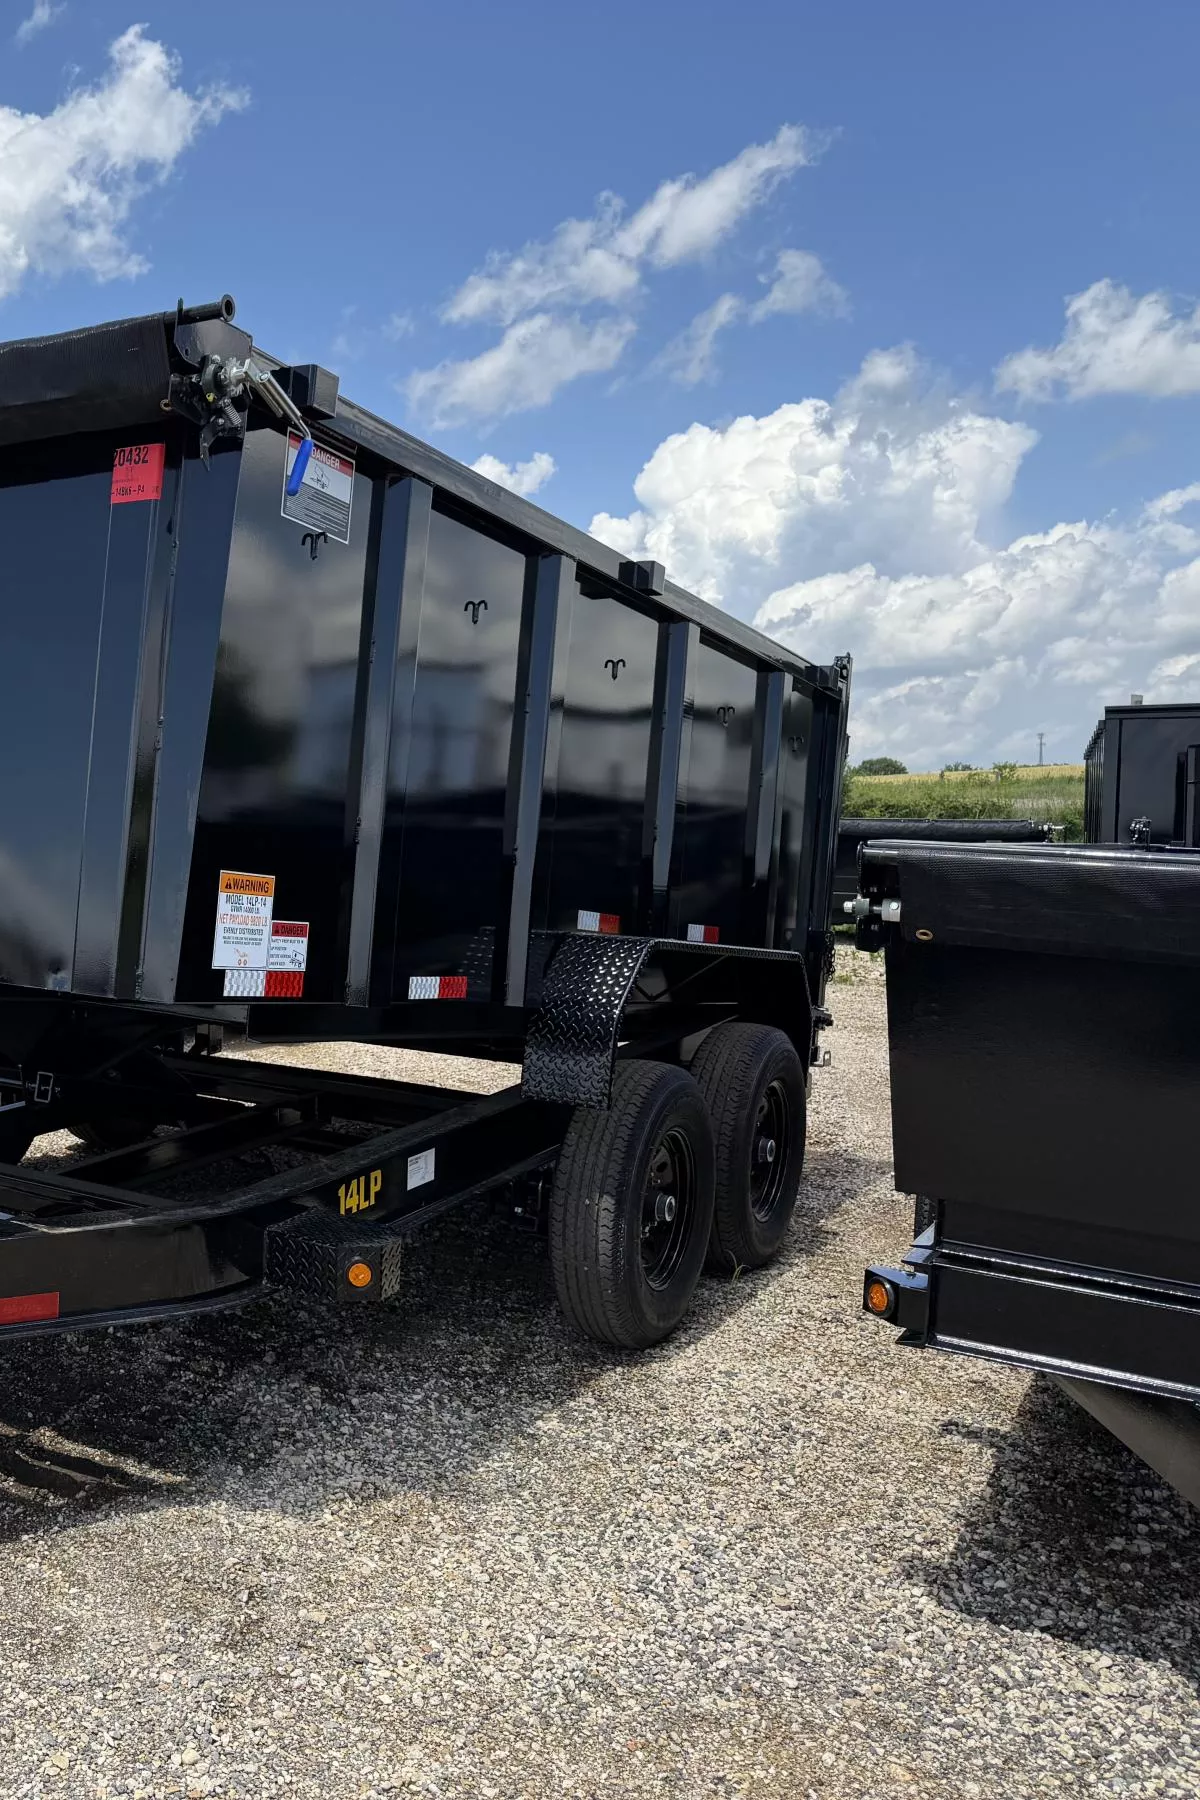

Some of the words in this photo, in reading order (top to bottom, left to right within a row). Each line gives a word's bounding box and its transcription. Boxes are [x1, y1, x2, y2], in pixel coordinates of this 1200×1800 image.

[311, 446, 340, 470] DANGER
[232, 879, 270, 893] WARNING
[225, 894, 244, 906] MODEL
[246, 897, 267, 907] 14LP-14
[229, 914, 249, 926] PAYLOAD
[338, 1169, 382, 1216] 14LP
